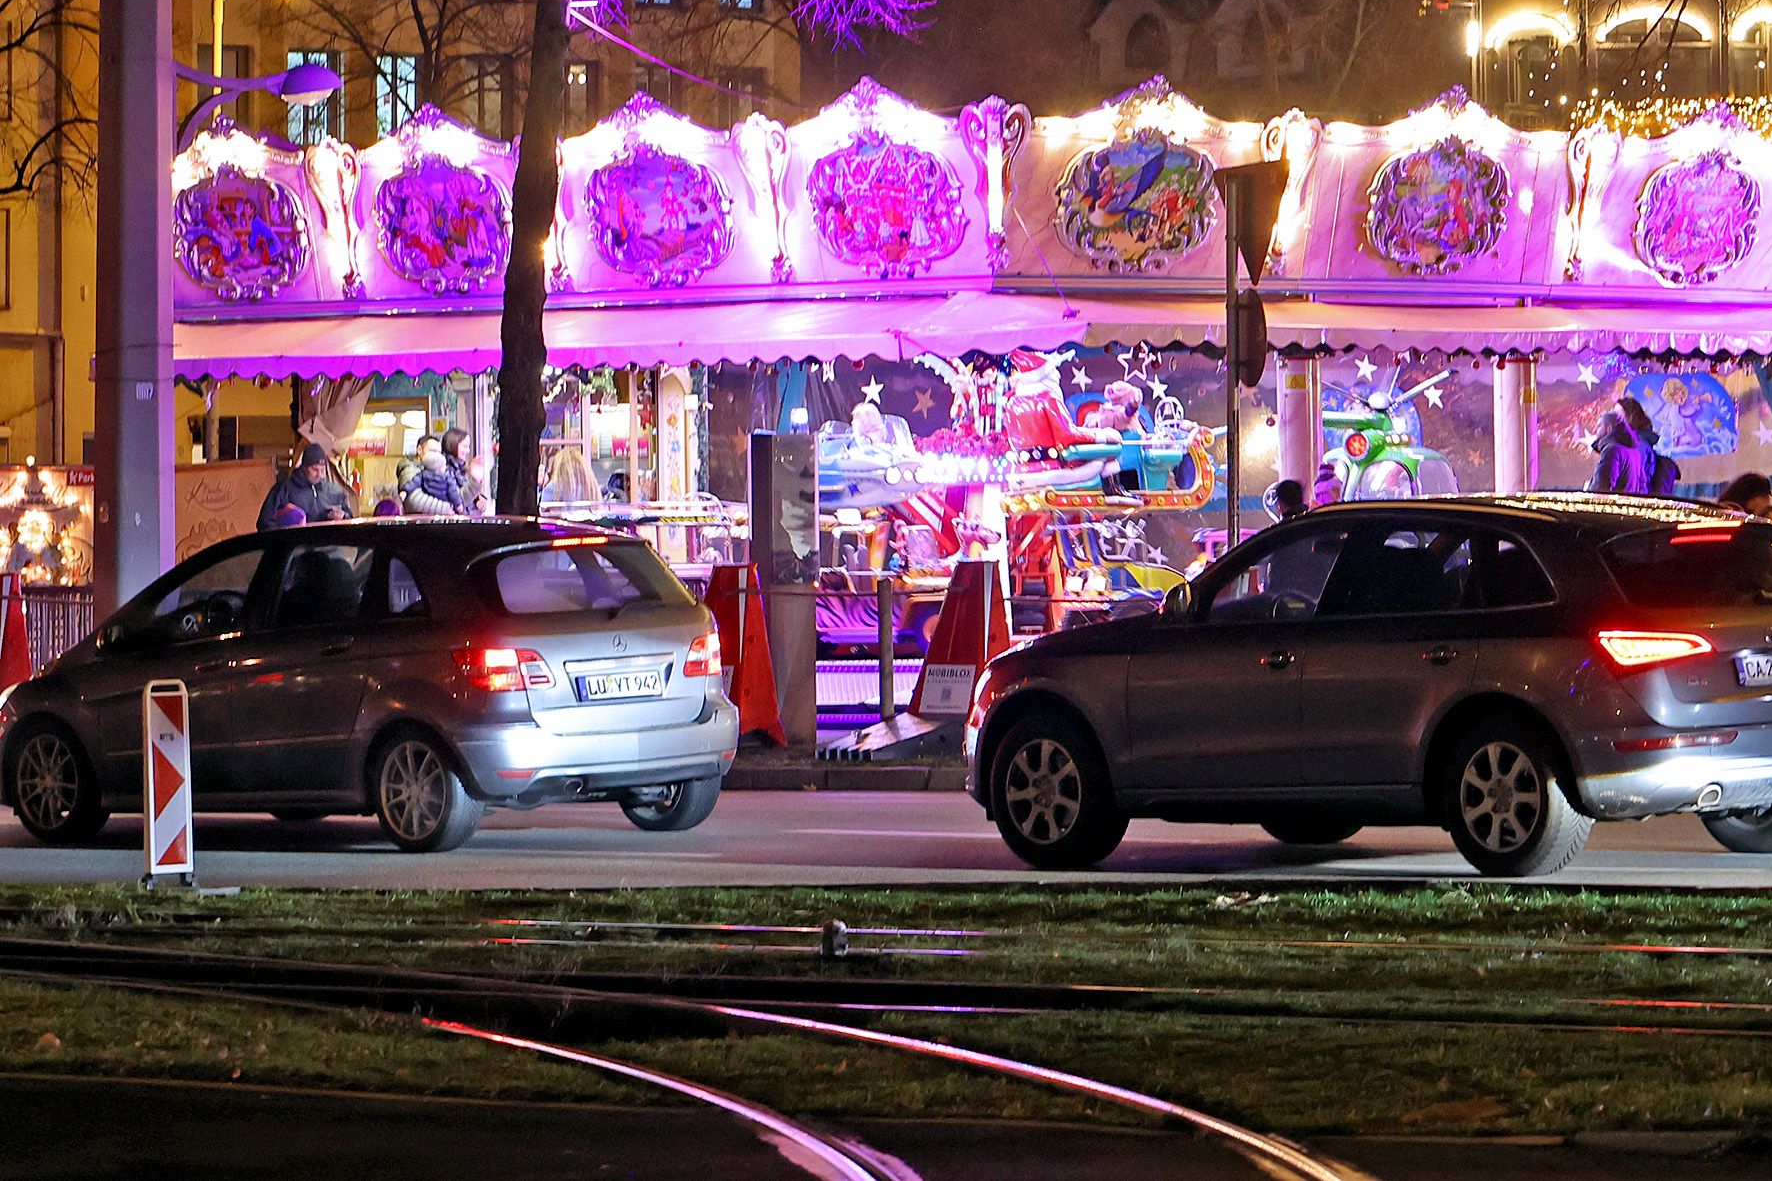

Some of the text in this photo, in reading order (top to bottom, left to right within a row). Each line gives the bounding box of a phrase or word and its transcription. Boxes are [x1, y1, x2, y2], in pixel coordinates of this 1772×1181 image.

[587, 674, 658, 696] LU YT 942
